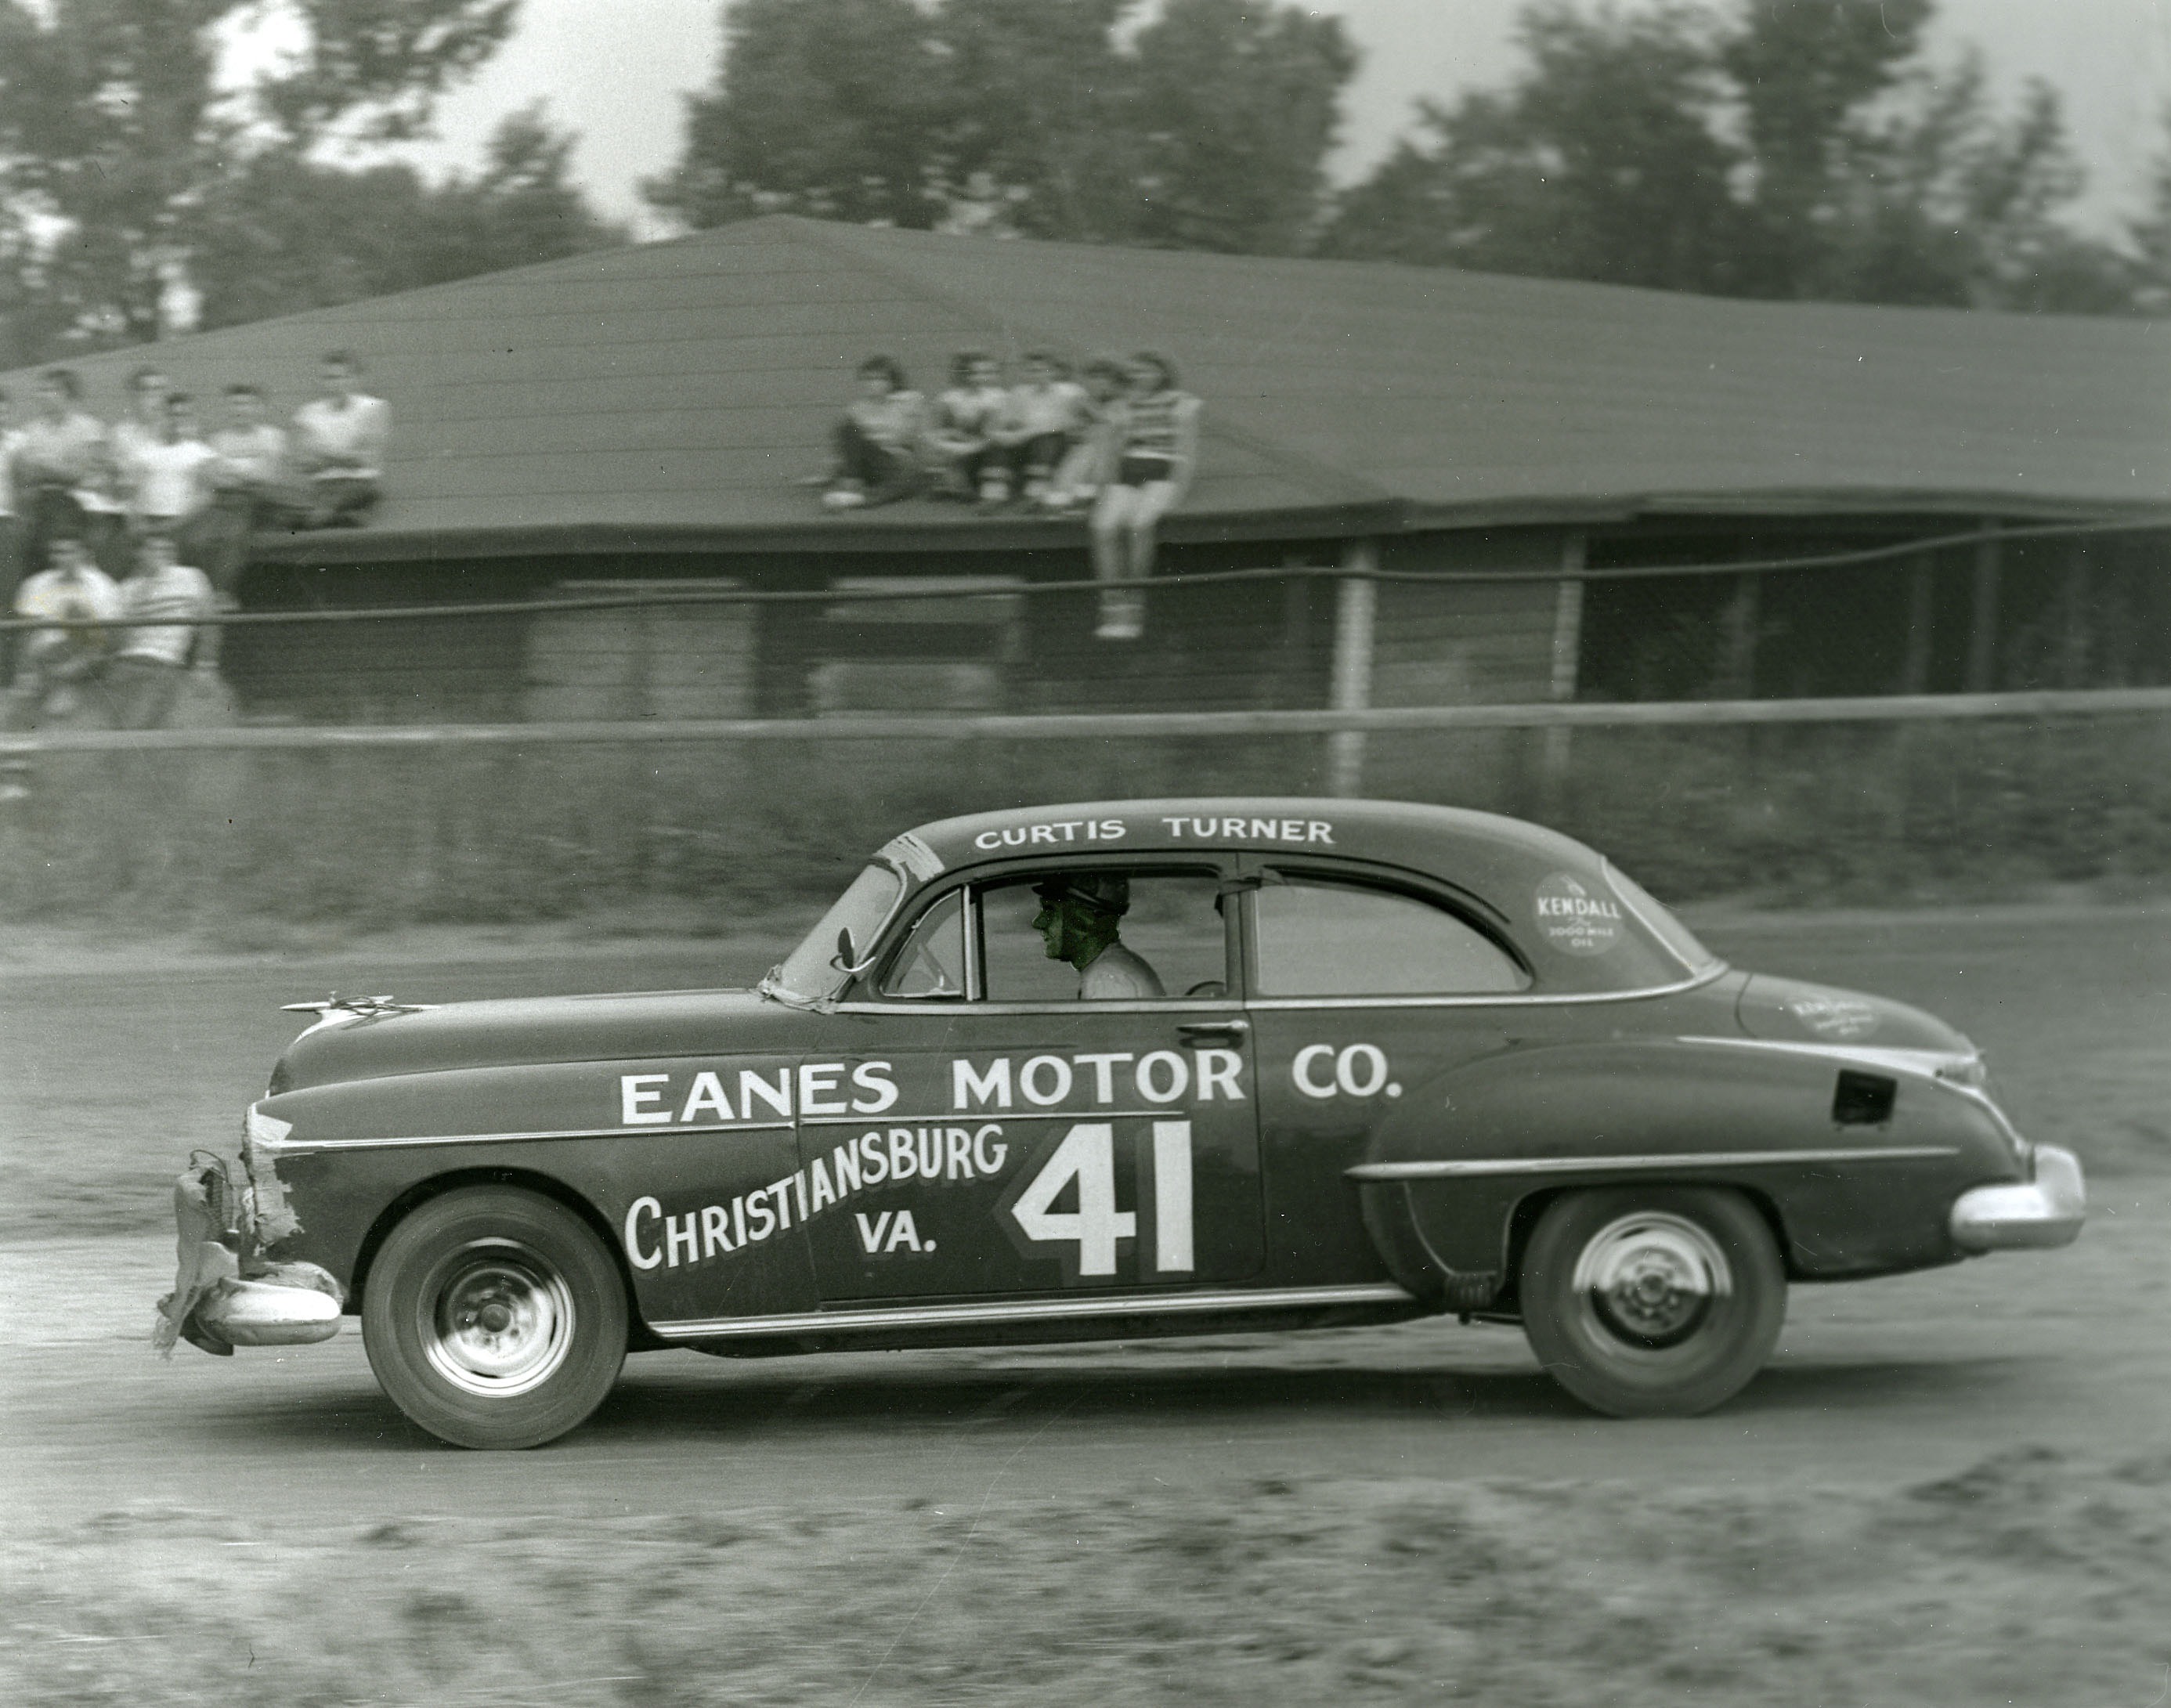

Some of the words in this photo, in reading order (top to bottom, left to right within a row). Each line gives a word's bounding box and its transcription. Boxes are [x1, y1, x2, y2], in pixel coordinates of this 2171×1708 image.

[974, 819, 1126, 850] CURTIS
[1161, 817, 1335, 844] TURNER
[1537, 897, 1622, 919] KENDALL
[620, 1061, 898, 1125] EANES
[952, 1049, 1244, 1109] MOTOR
[1293, 1044, 1402, 1097] CO.
[625, 1124, 1009, 1270] CHRISTIANSBURG
[1011, 1120, 1194, 1276] 41
[855, 1210, 937, 1253] VA.
